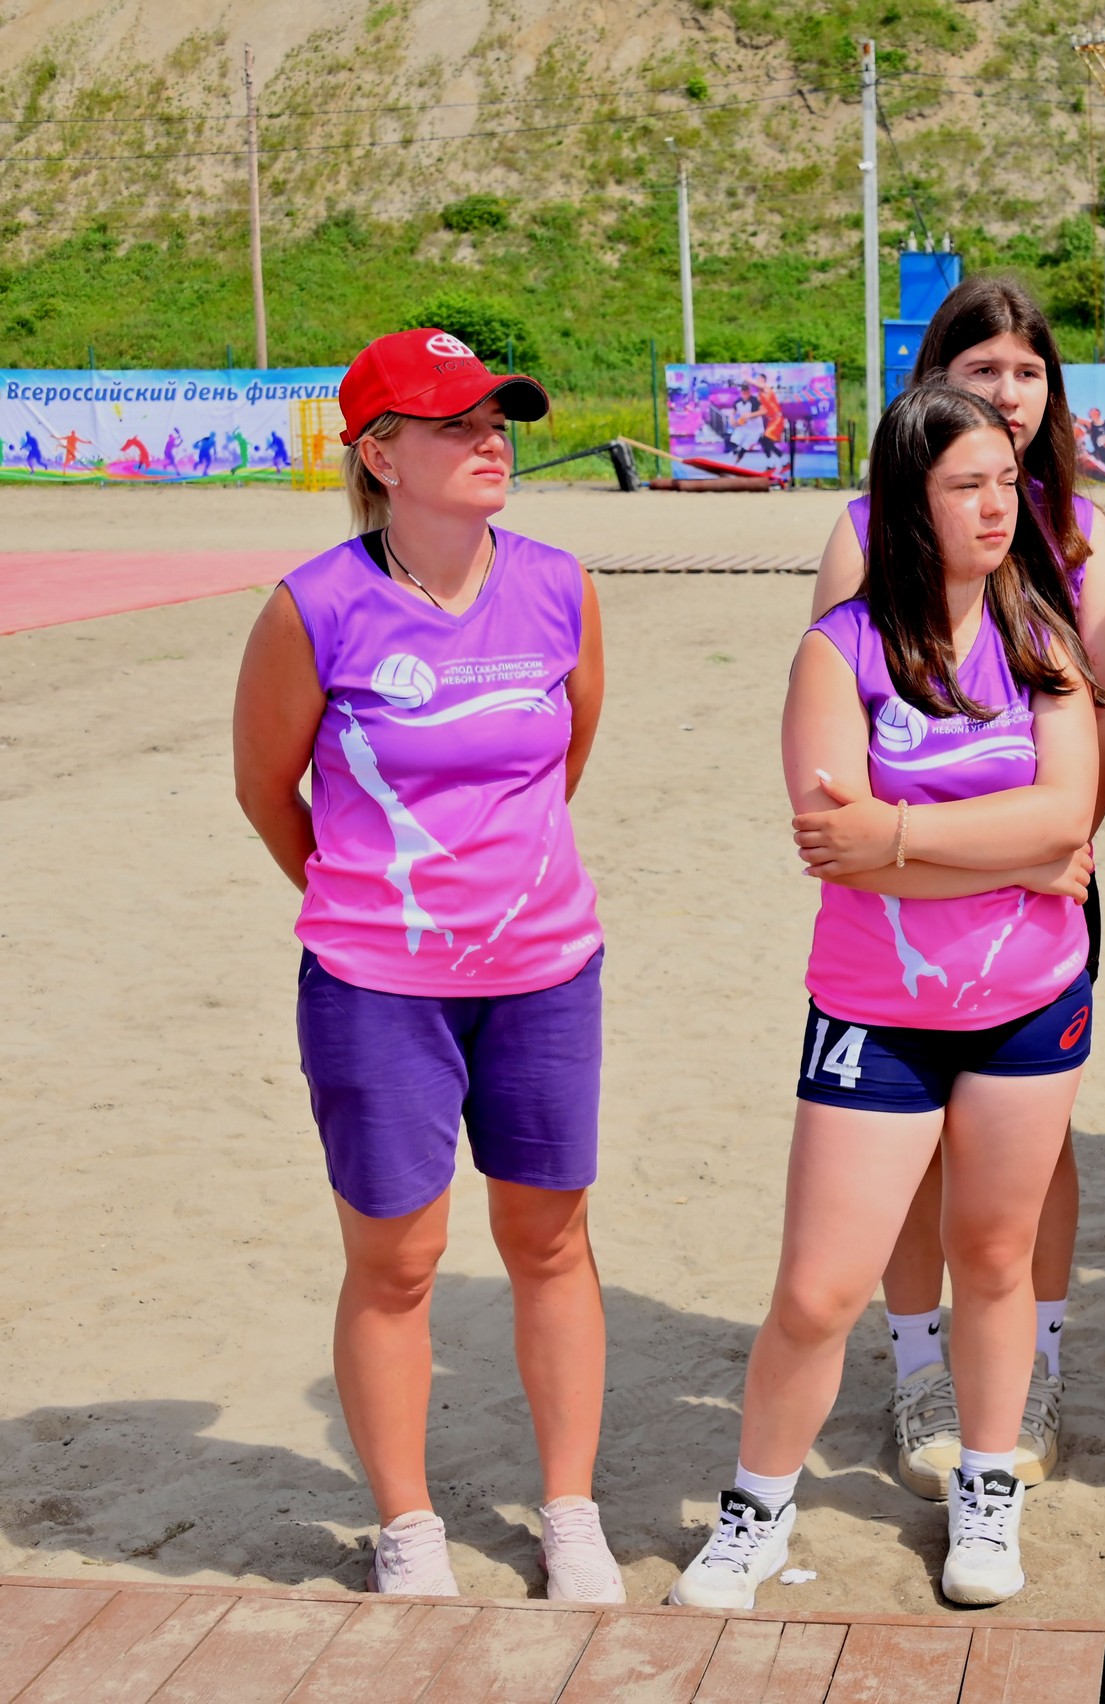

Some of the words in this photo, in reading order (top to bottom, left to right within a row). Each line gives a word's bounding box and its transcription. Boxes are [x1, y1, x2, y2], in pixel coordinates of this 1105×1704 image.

[6, 381, 178, 406] Всероссийский
[184, 381, 238, 401] день
[806, 1017, 868, 1089] 14
